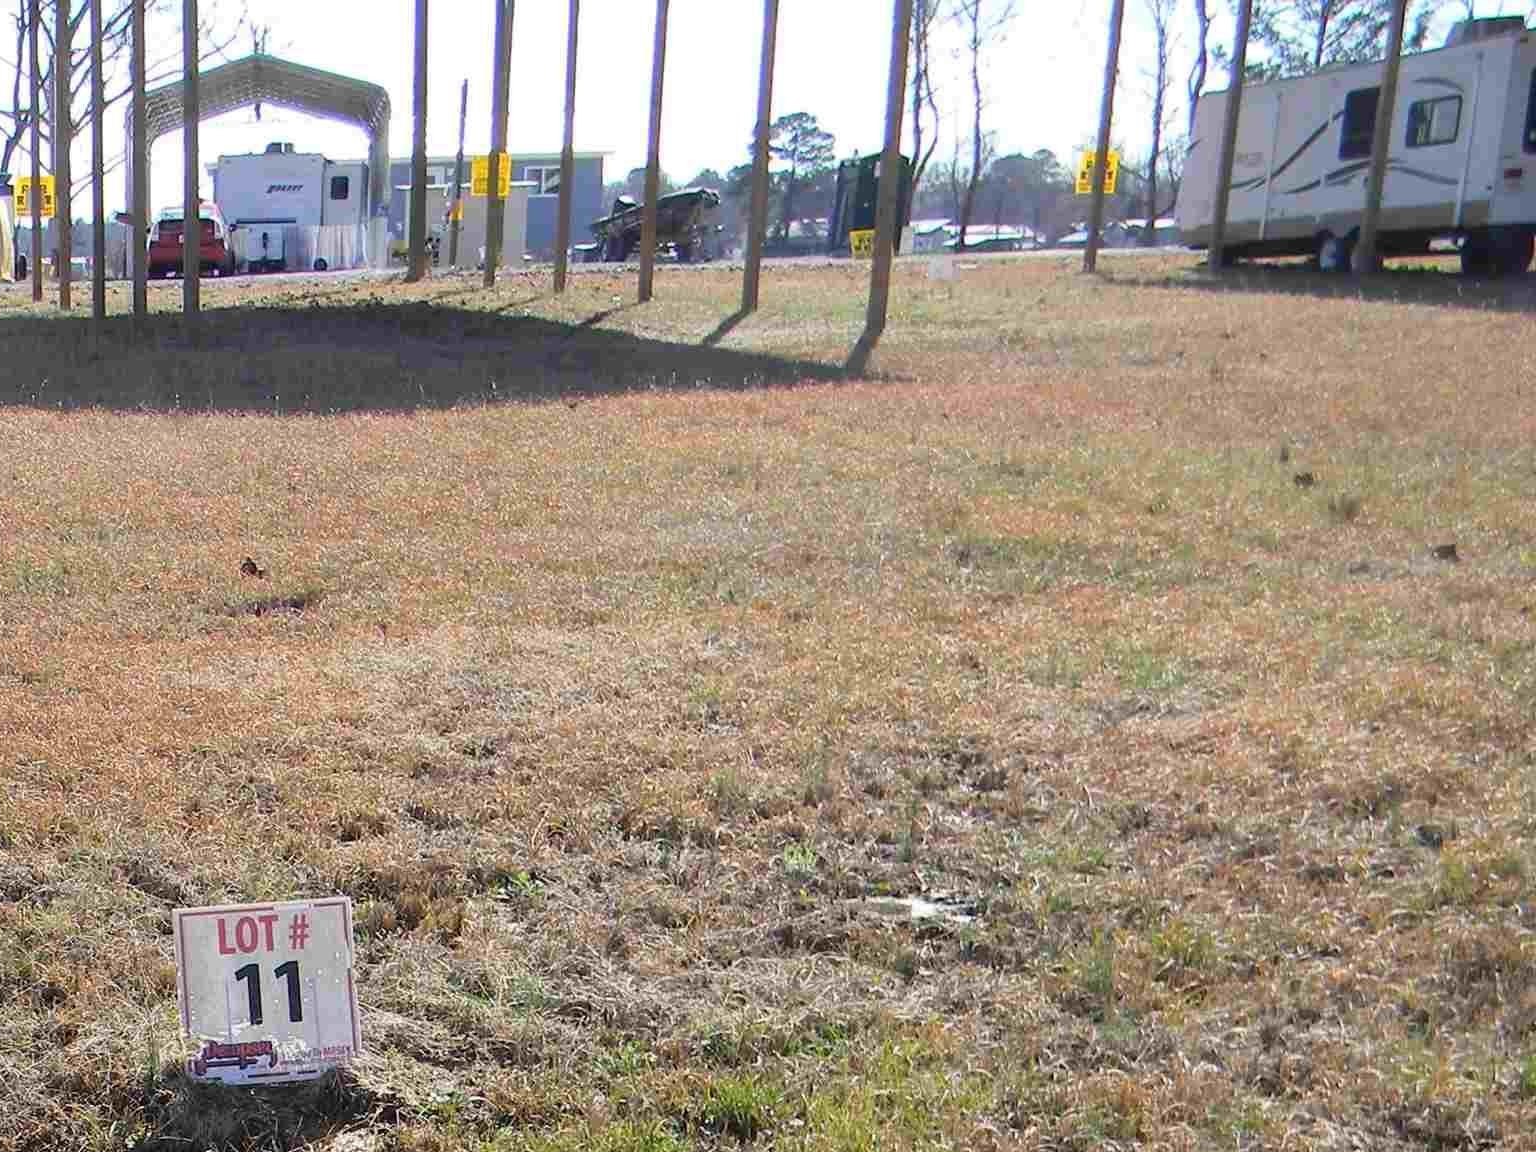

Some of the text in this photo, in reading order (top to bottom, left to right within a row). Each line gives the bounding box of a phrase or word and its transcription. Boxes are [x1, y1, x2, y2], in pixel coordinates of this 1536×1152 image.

[217, 913, 309, 954] LOT #
[234, 960, 302, 1025] 11
